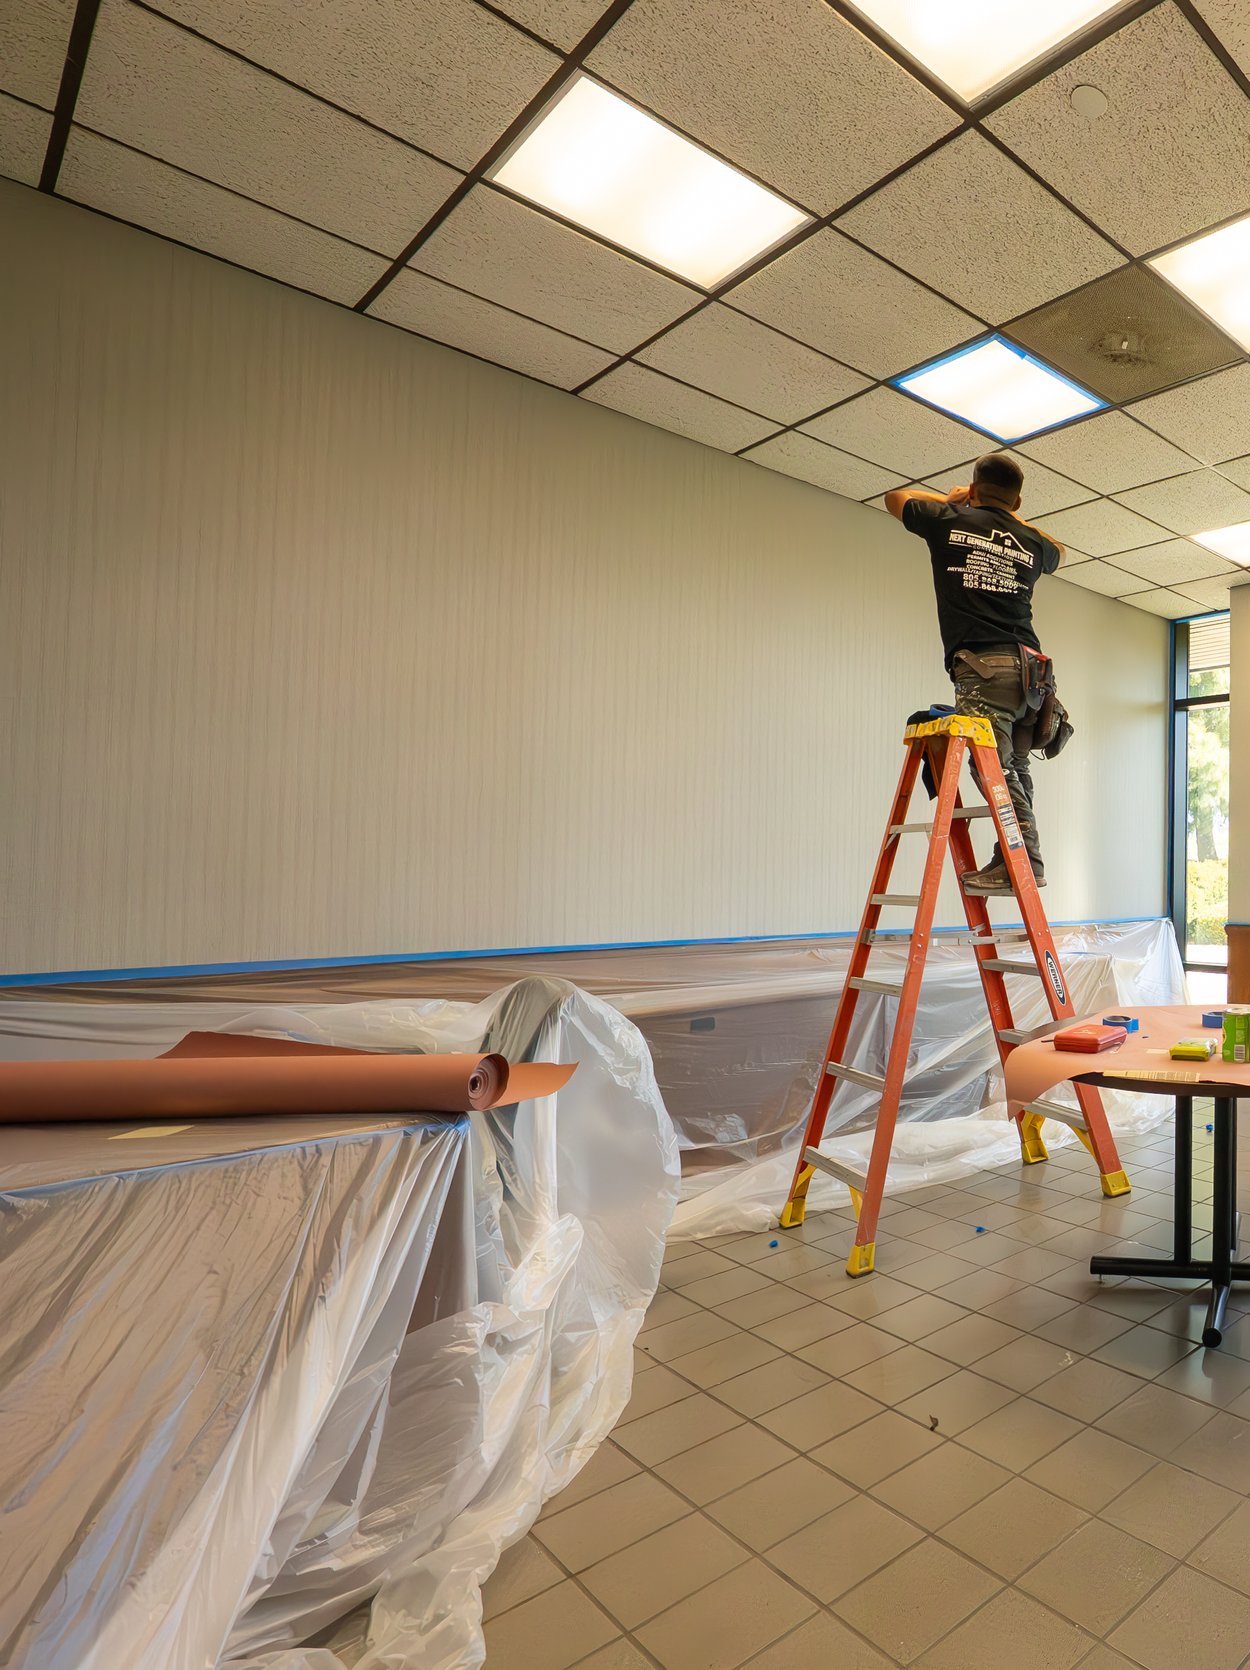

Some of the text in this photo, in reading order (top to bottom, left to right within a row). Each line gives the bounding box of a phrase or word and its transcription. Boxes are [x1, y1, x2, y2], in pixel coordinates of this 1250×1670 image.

[949, 533, 966, 543] NEXT
[967, 536, 1003, 553] GENERATION
[1003, 547, 1029, 563] PAINTING
[1048, 961, 1062, 995] WERNER
